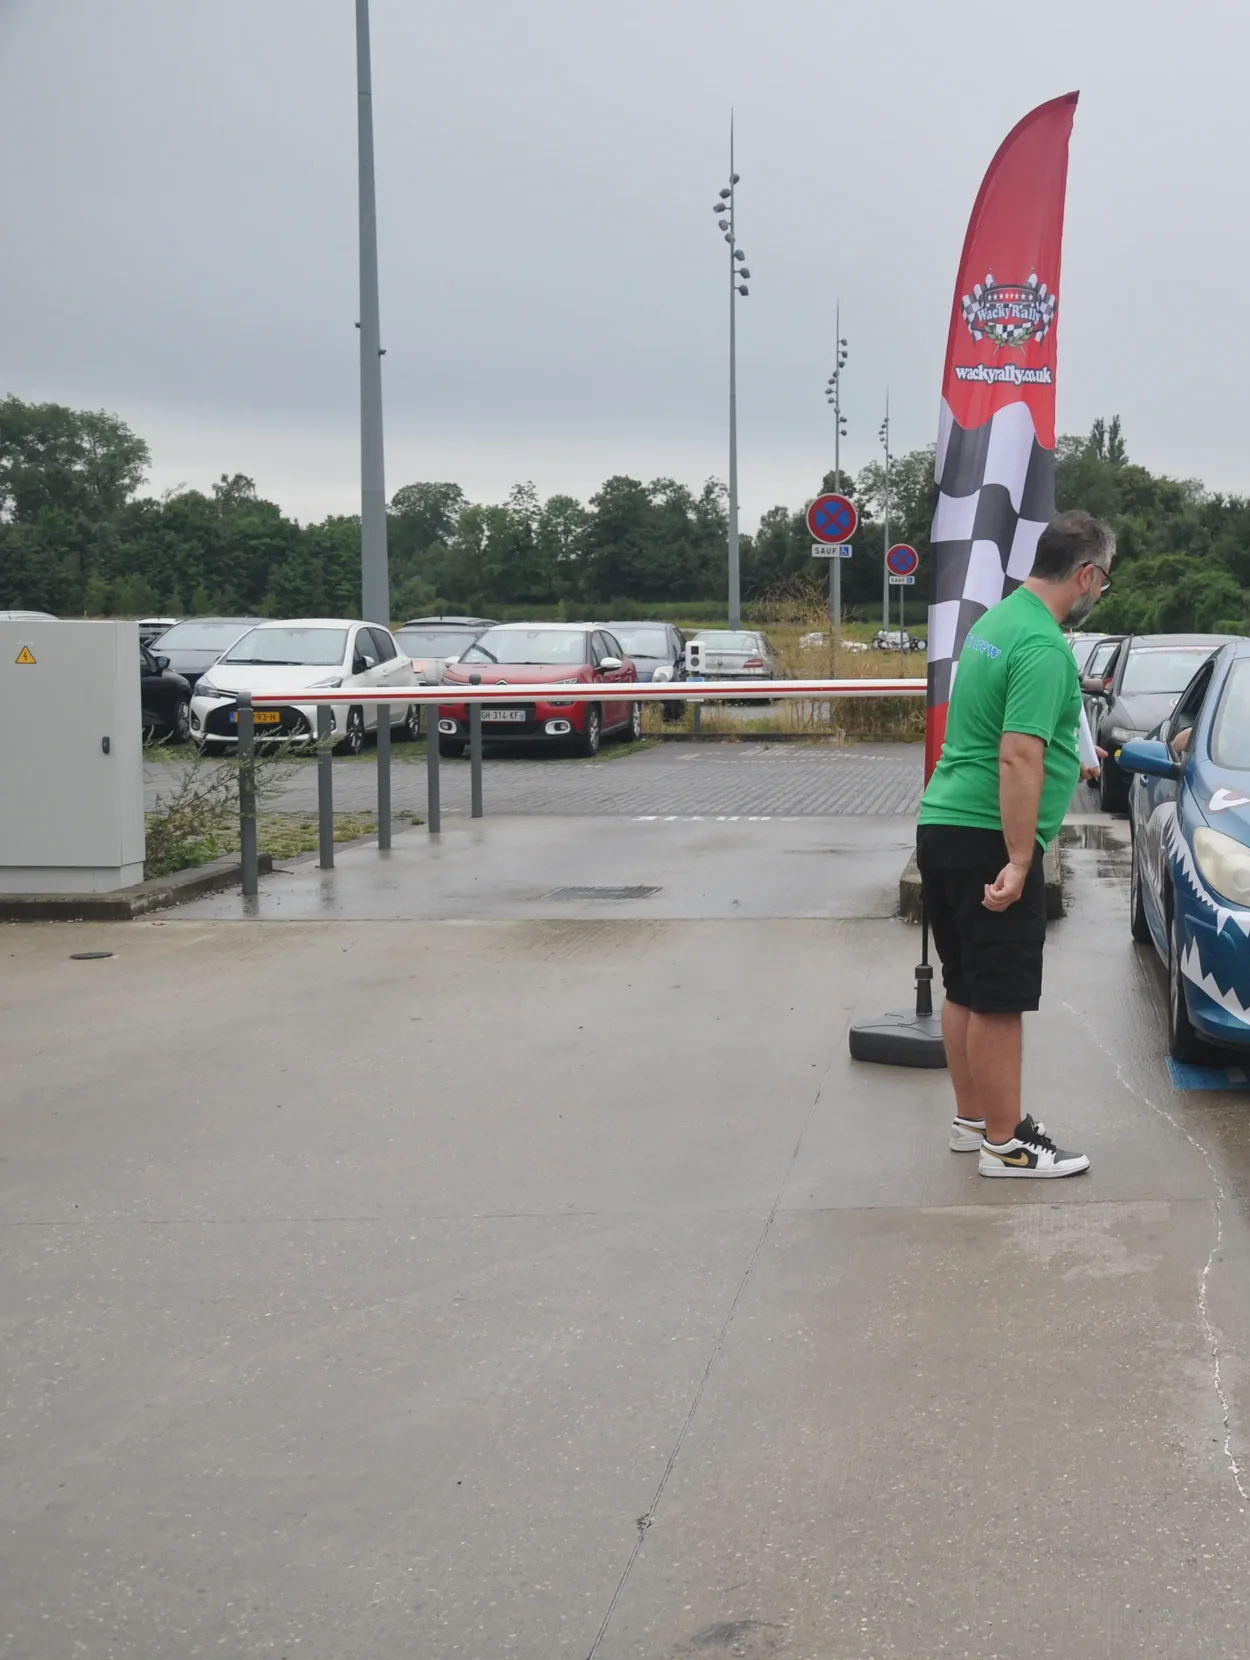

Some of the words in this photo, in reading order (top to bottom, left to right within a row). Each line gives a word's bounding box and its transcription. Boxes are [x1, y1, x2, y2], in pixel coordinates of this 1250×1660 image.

[976, 304, 1010, 322] Wacky
[1012, 304, 1042, 324] Rally
[955, 364, 1052, 385] wackyrally.co.uk
[481, 711, 519, 719] GH-314-KF
